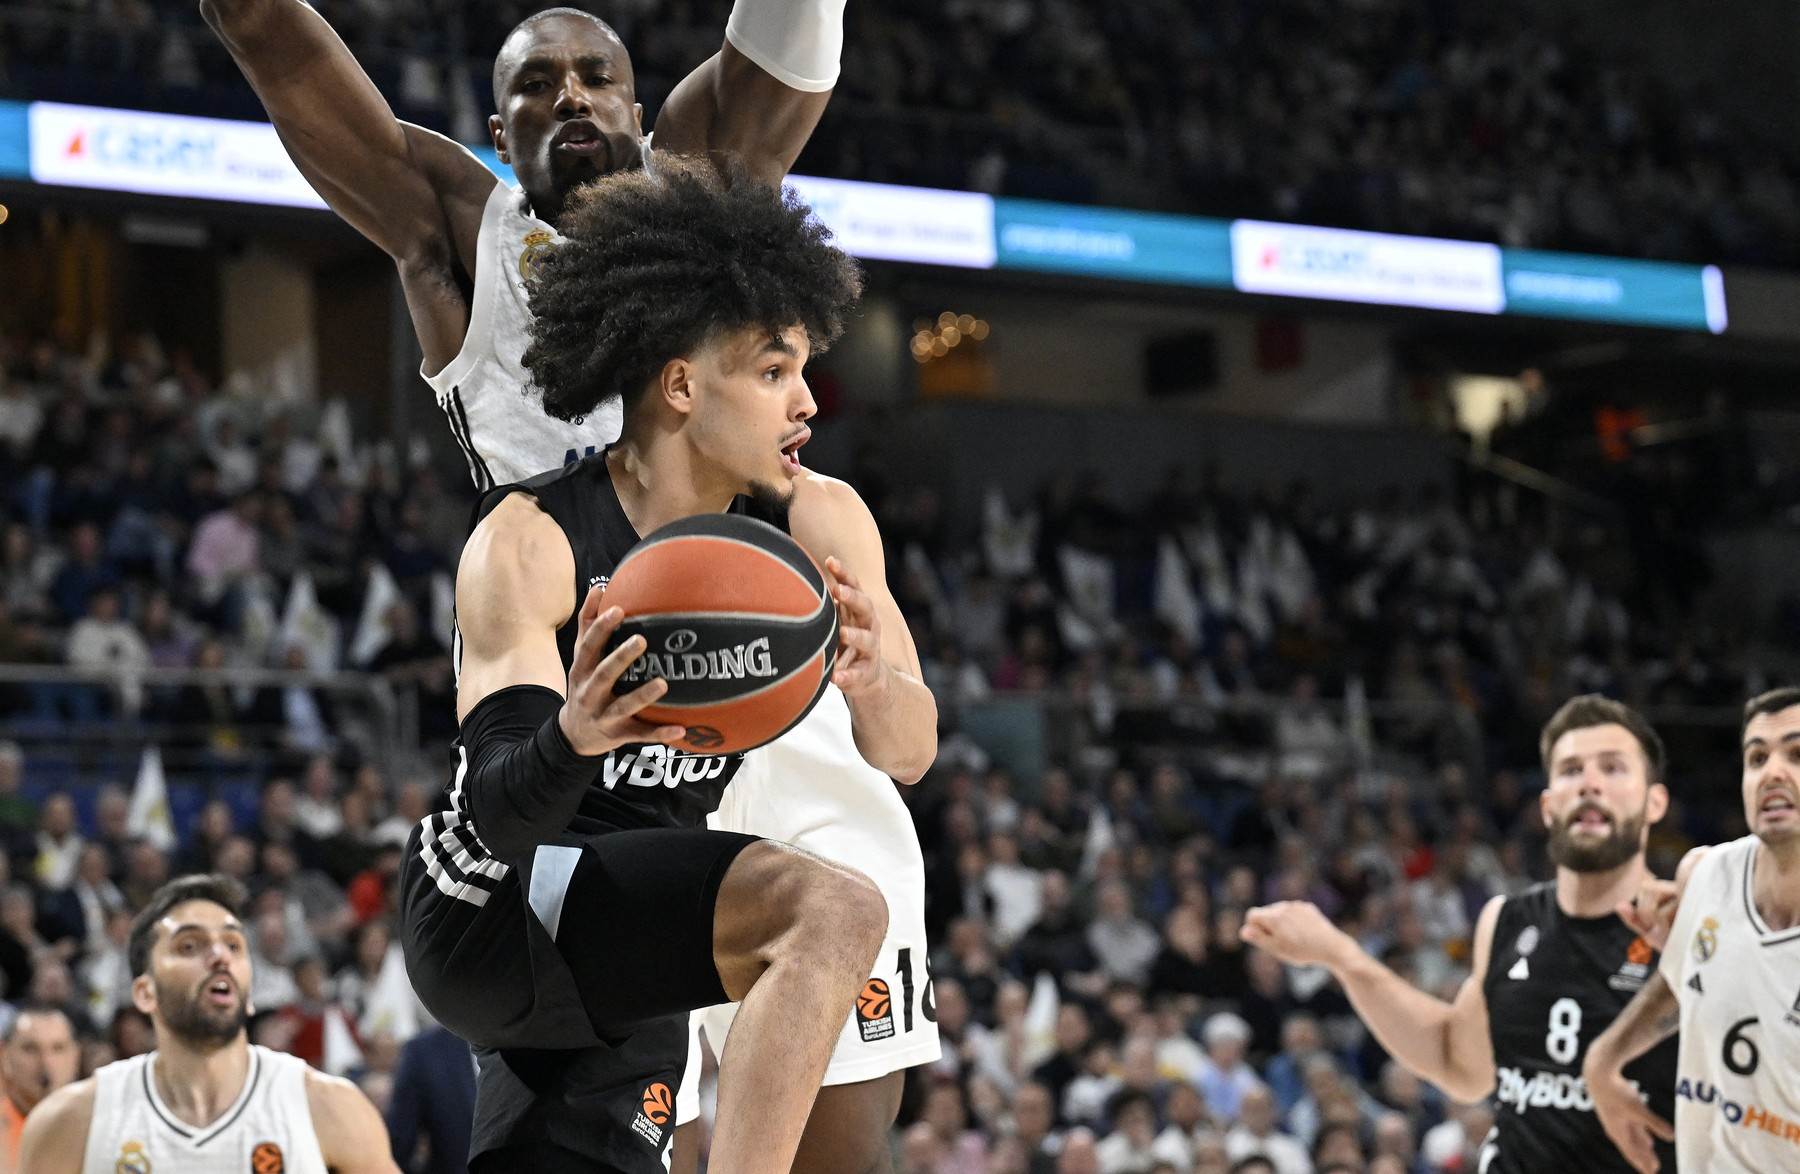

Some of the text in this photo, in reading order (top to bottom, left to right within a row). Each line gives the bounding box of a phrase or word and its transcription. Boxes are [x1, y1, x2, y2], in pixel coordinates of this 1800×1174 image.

[622, 637, 776, 682] PALDING
[862, 1016, 892, 1029] TURKISH
[1545, 997, 1583, 1065] 8
[1722, 1016, 1760, 1076] 6
[633, 1118, 660, 1143] AIRLINES
[637, 1111, 663, 1138] TURKISH
[1675, 1078, 1800, 1146] AUOHER
